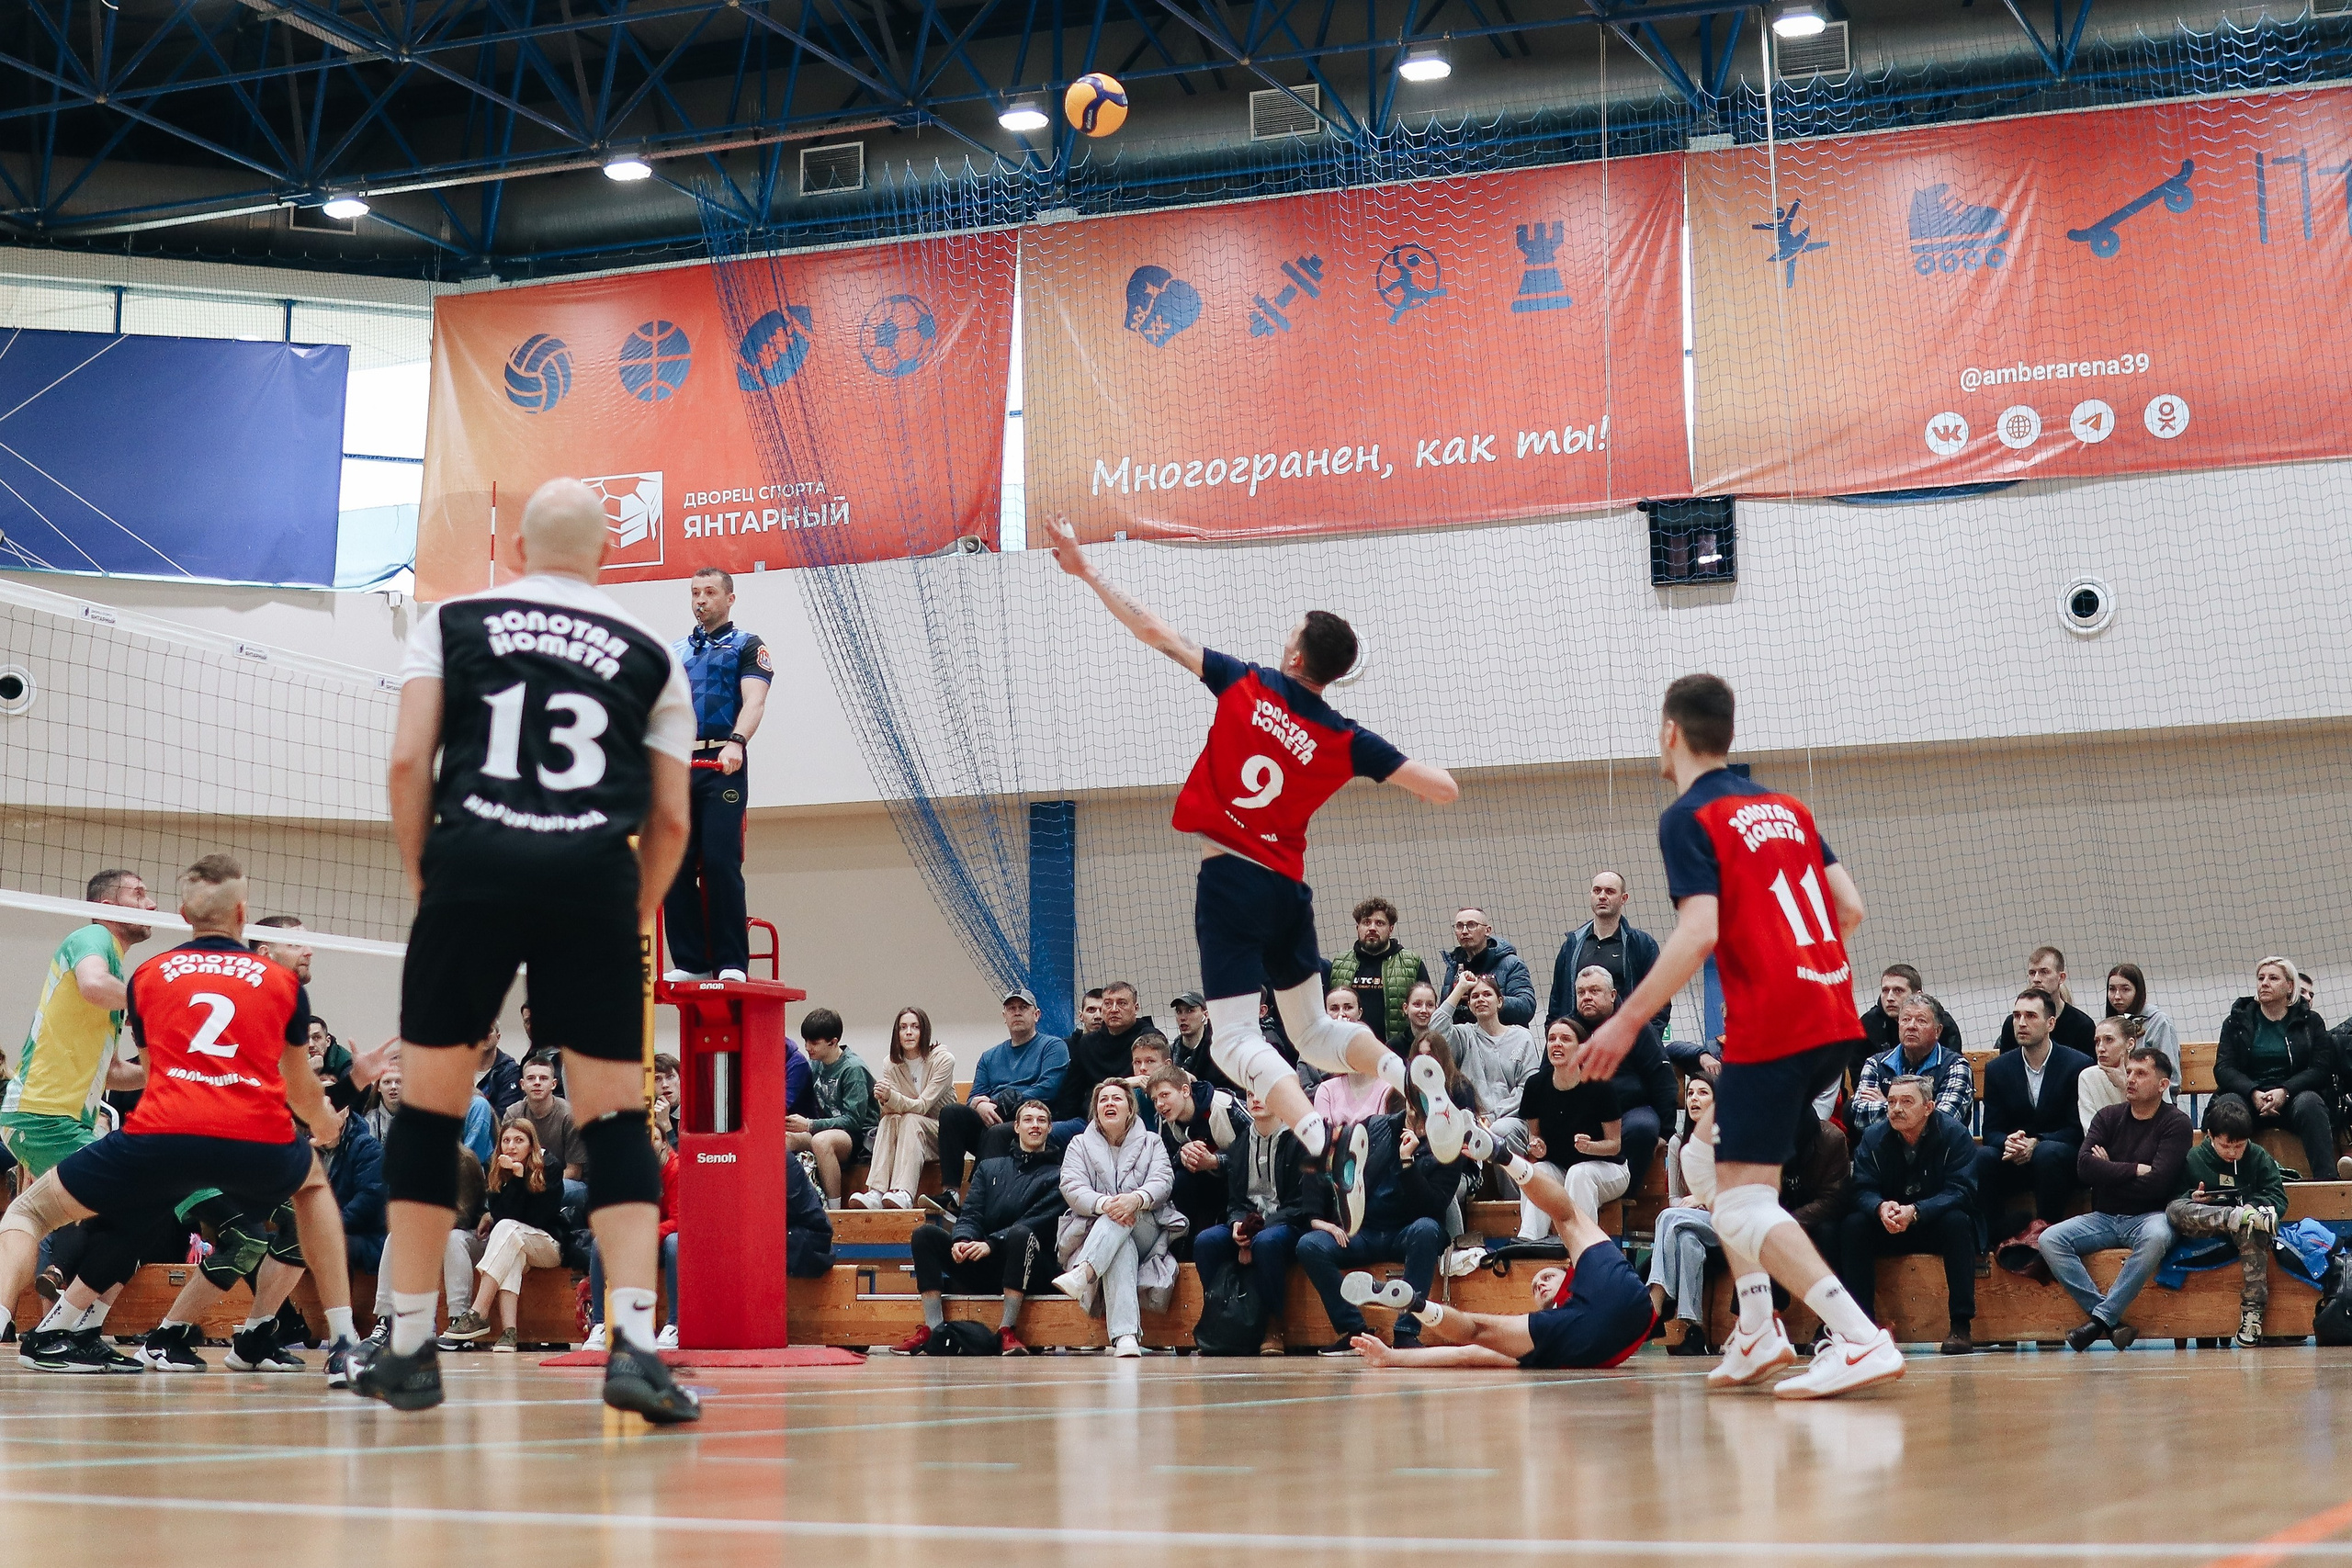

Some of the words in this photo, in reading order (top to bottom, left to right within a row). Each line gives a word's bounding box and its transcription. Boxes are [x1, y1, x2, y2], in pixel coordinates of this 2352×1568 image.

[1960, 352, 2151, 392] @amberarena39
[1091, 441, 1393, 497] Многогранен,
[1416, 431, 1497, 468] как
[1516, 413, 1611, 460] ты!
[684, 486, 754, 509] ДВОРЕЦ
[759, 480, 827, 501] СПОРТА
[684, 495, 850, 539] ЯНТАРНЫЙ
[479, 681, 609, 791] 13
[1231, 754, 1284, 809] 9
[1768, 863, 1838, 947] 11
[187, 992, 240, 1059] 2
[696, 1152, 737, 1164] Senoh
